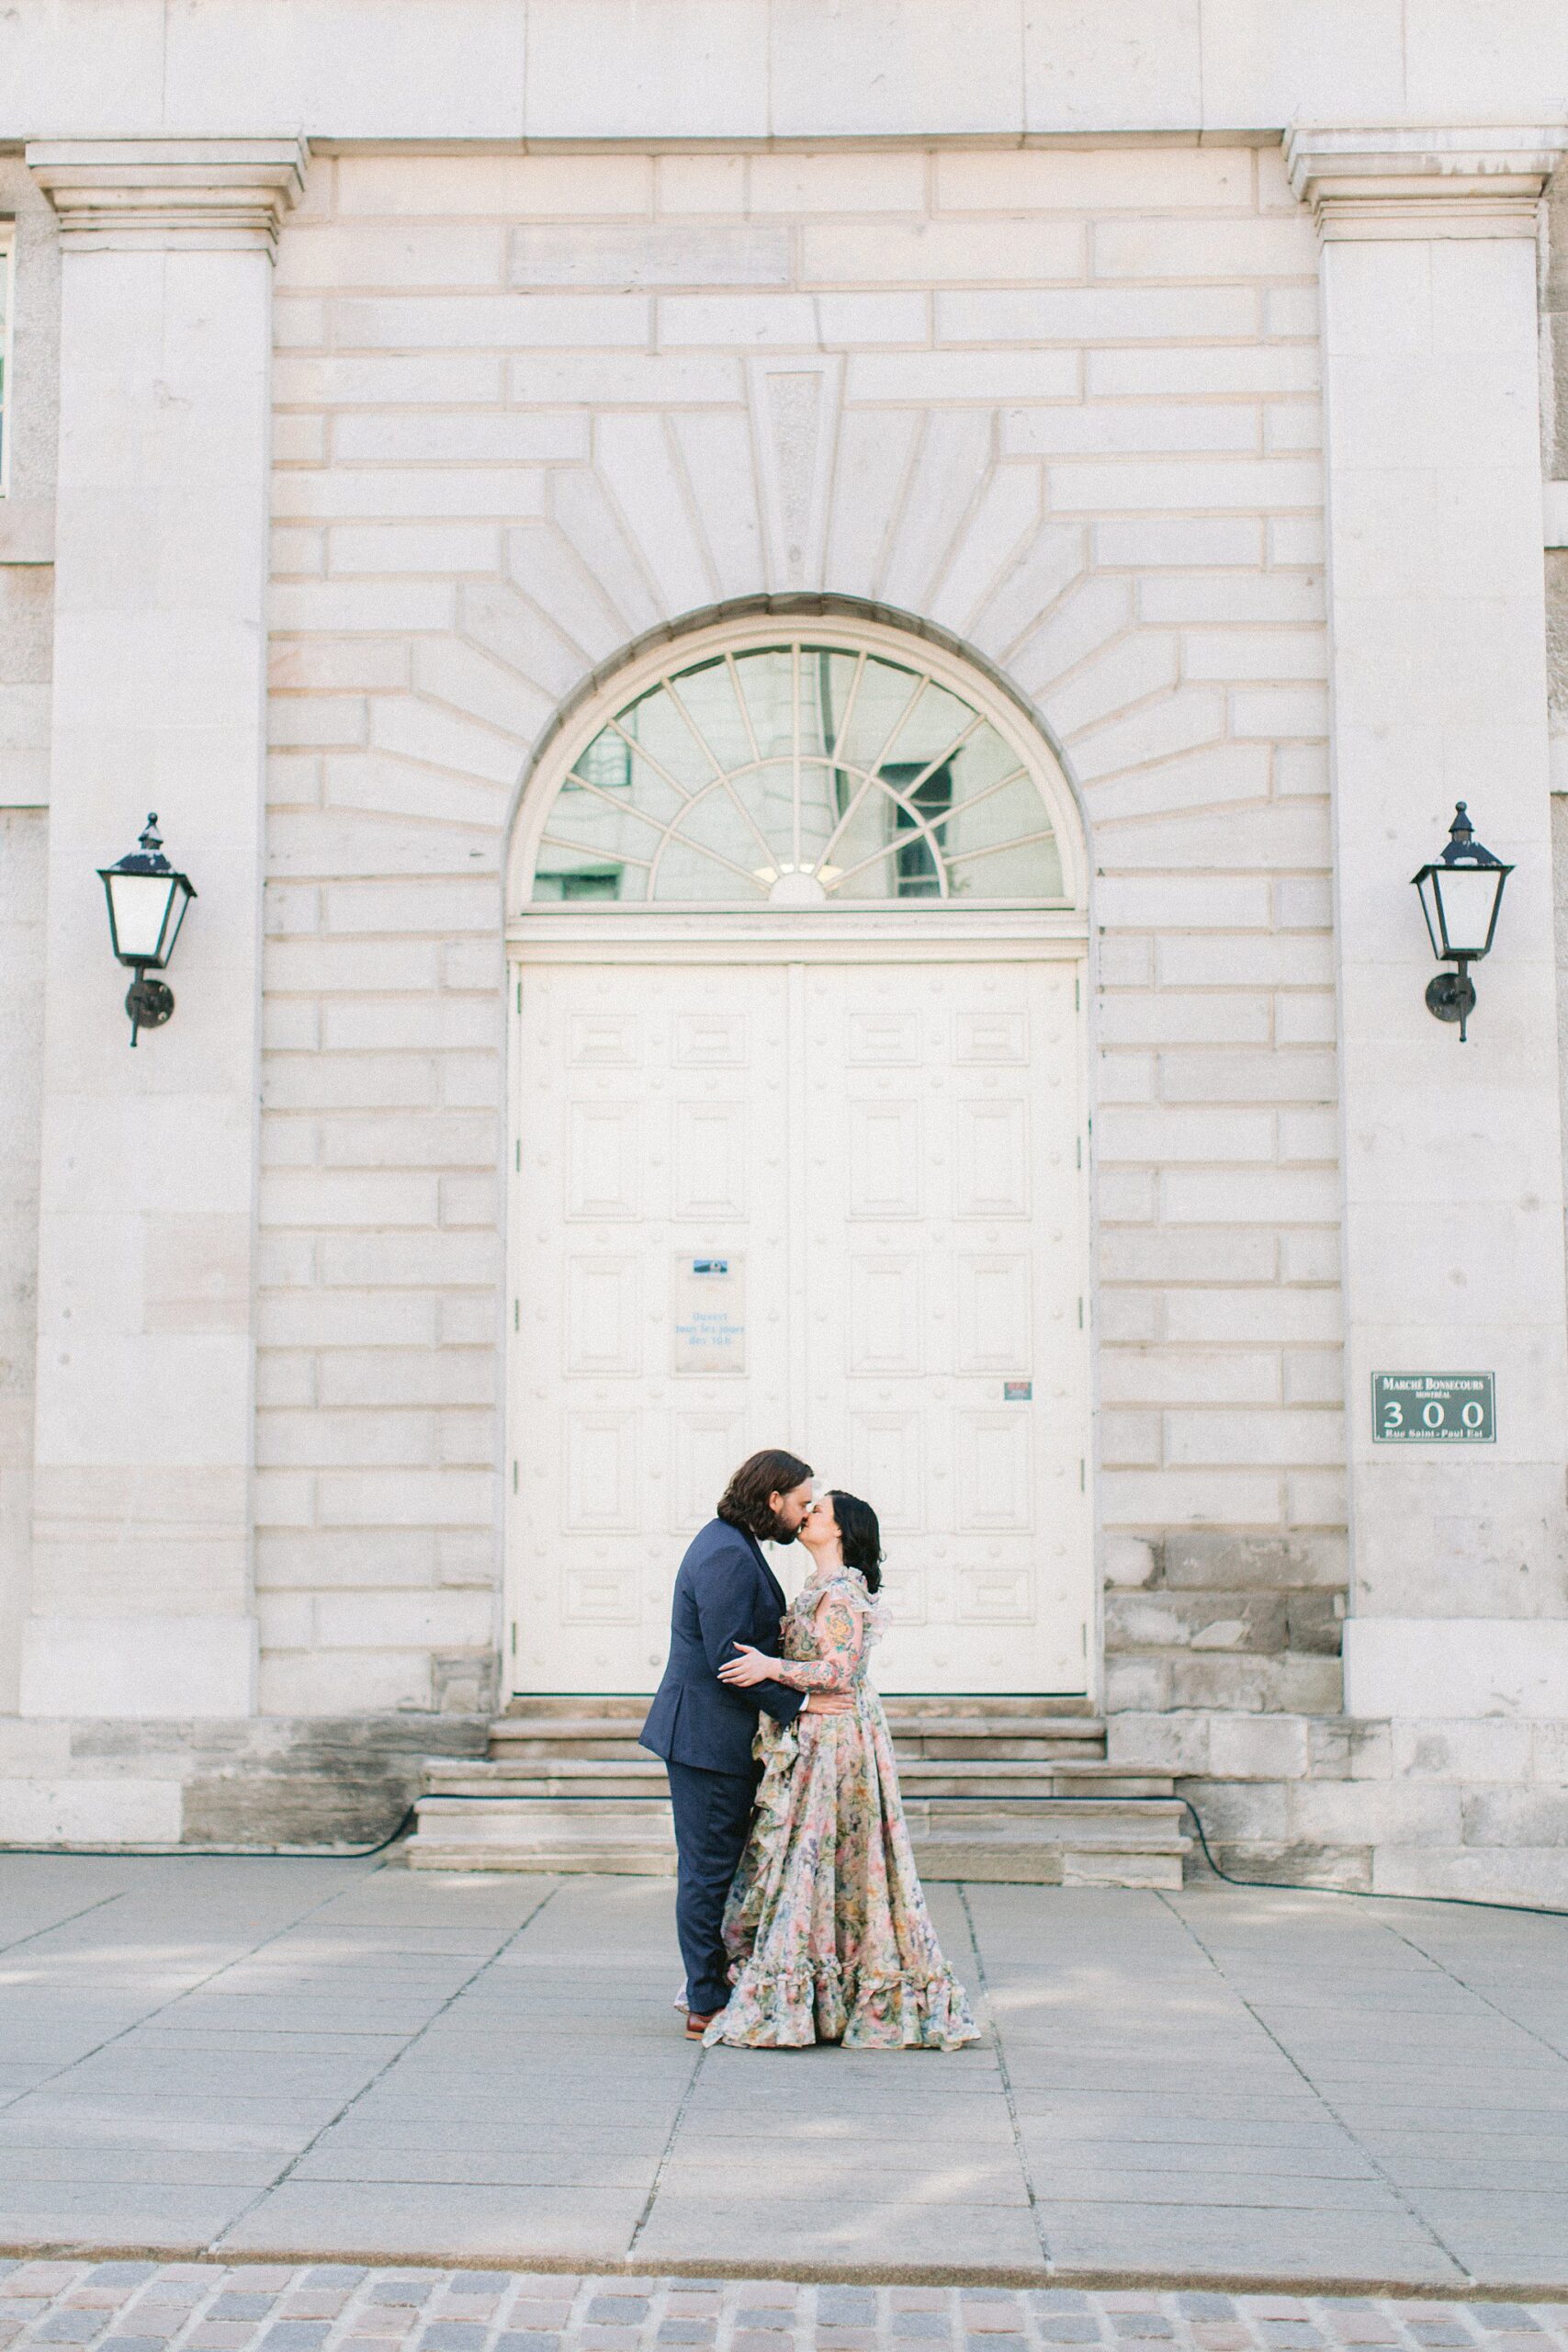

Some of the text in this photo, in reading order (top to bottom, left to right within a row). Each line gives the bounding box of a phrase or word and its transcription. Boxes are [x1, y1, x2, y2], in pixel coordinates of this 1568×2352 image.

[1385, 1429, 1483, 1439] Rue Saint-Paul Est
